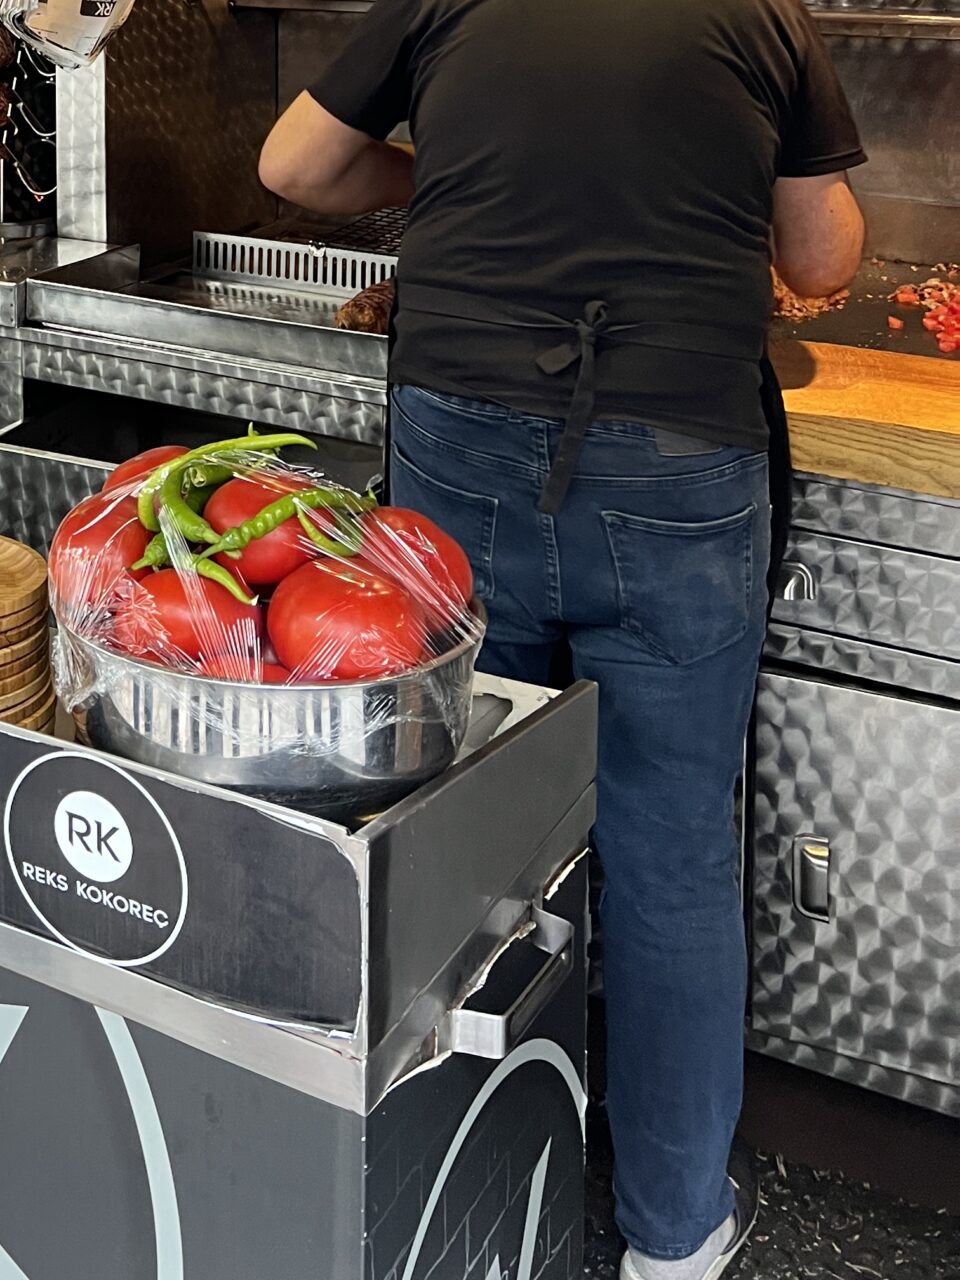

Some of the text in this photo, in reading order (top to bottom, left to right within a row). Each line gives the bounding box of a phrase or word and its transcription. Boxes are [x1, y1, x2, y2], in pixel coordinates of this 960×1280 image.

[94, 2, 114, 16] RK
[65, 810, 123, 864] RK
[21, 861, 69, 892] REKS
